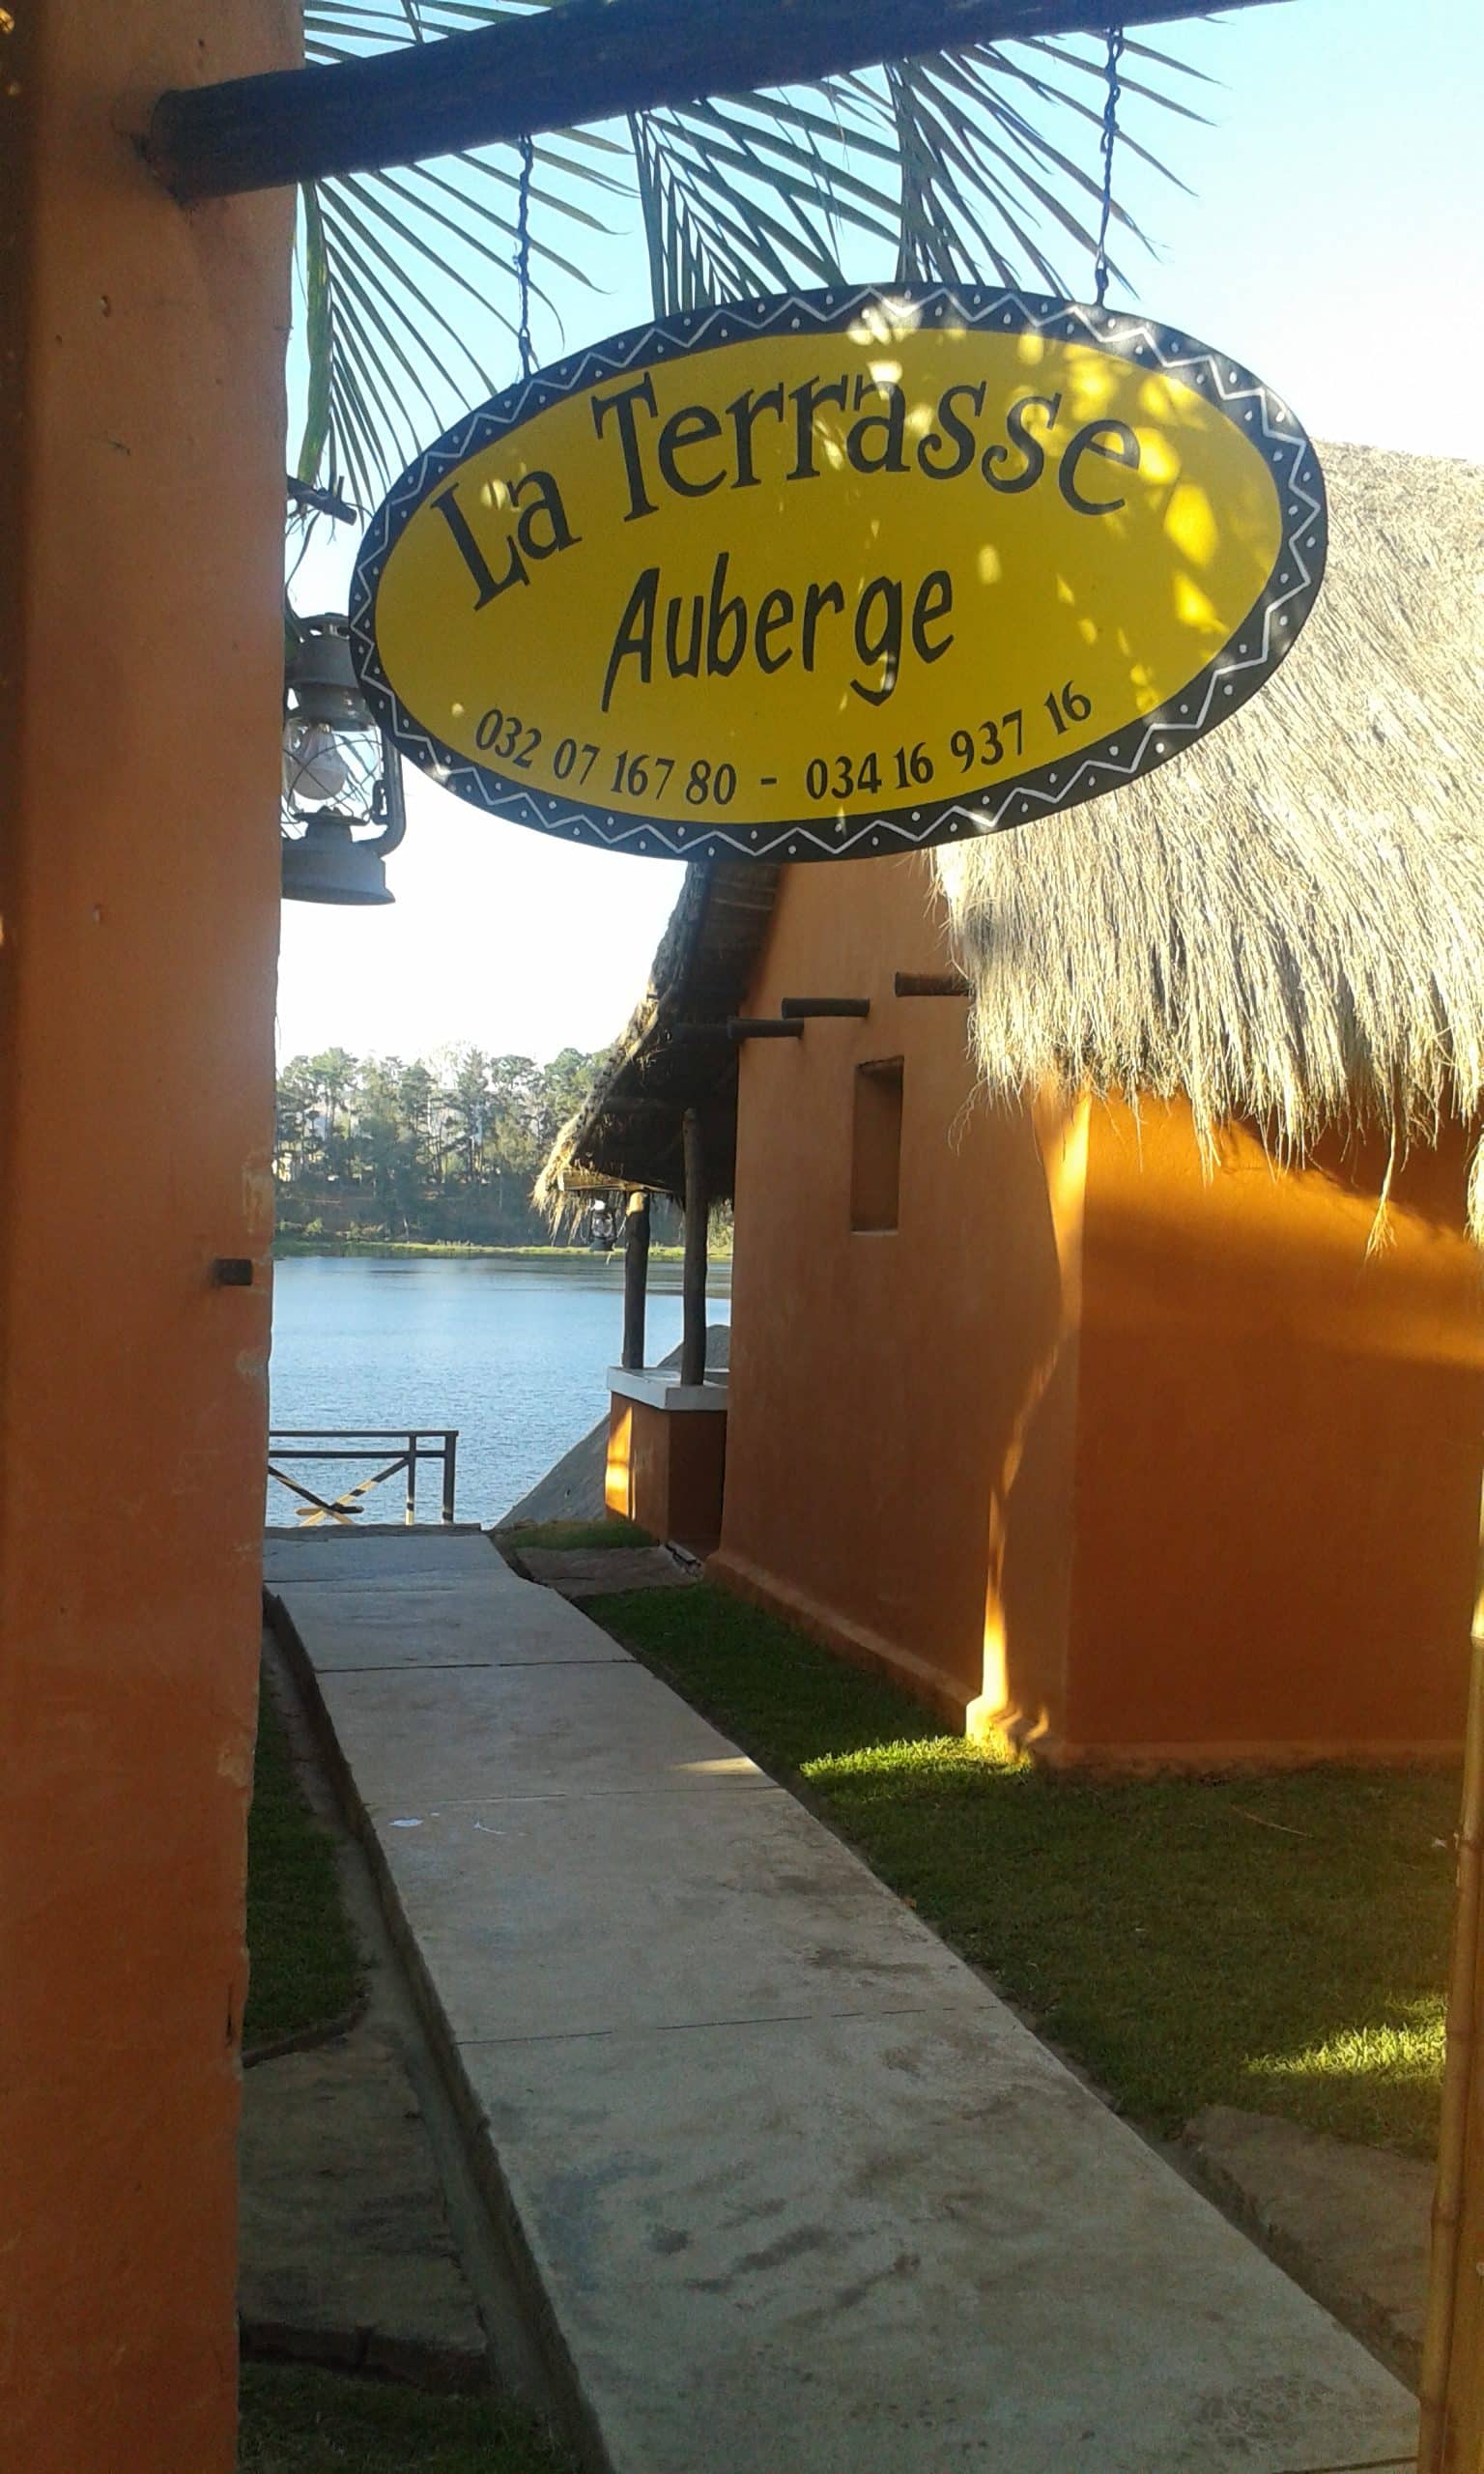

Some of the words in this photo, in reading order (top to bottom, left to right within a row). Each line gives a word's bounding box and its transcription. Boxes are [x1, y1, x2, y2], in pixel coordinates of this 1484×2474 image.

[430, 470, 583, 611] La
[590, 371, 1141, 523] Terrasse
[601, 552, 955, 713] Auberge
[475, 709, 542, 768] 032
[554, 738, 600, 785] 07
[611, 750, 674, 800] 167
[685, 760, 737, 805] 80
[950, 709, 1022, 773] 937
[1044, 680, 1092, 734] 16
